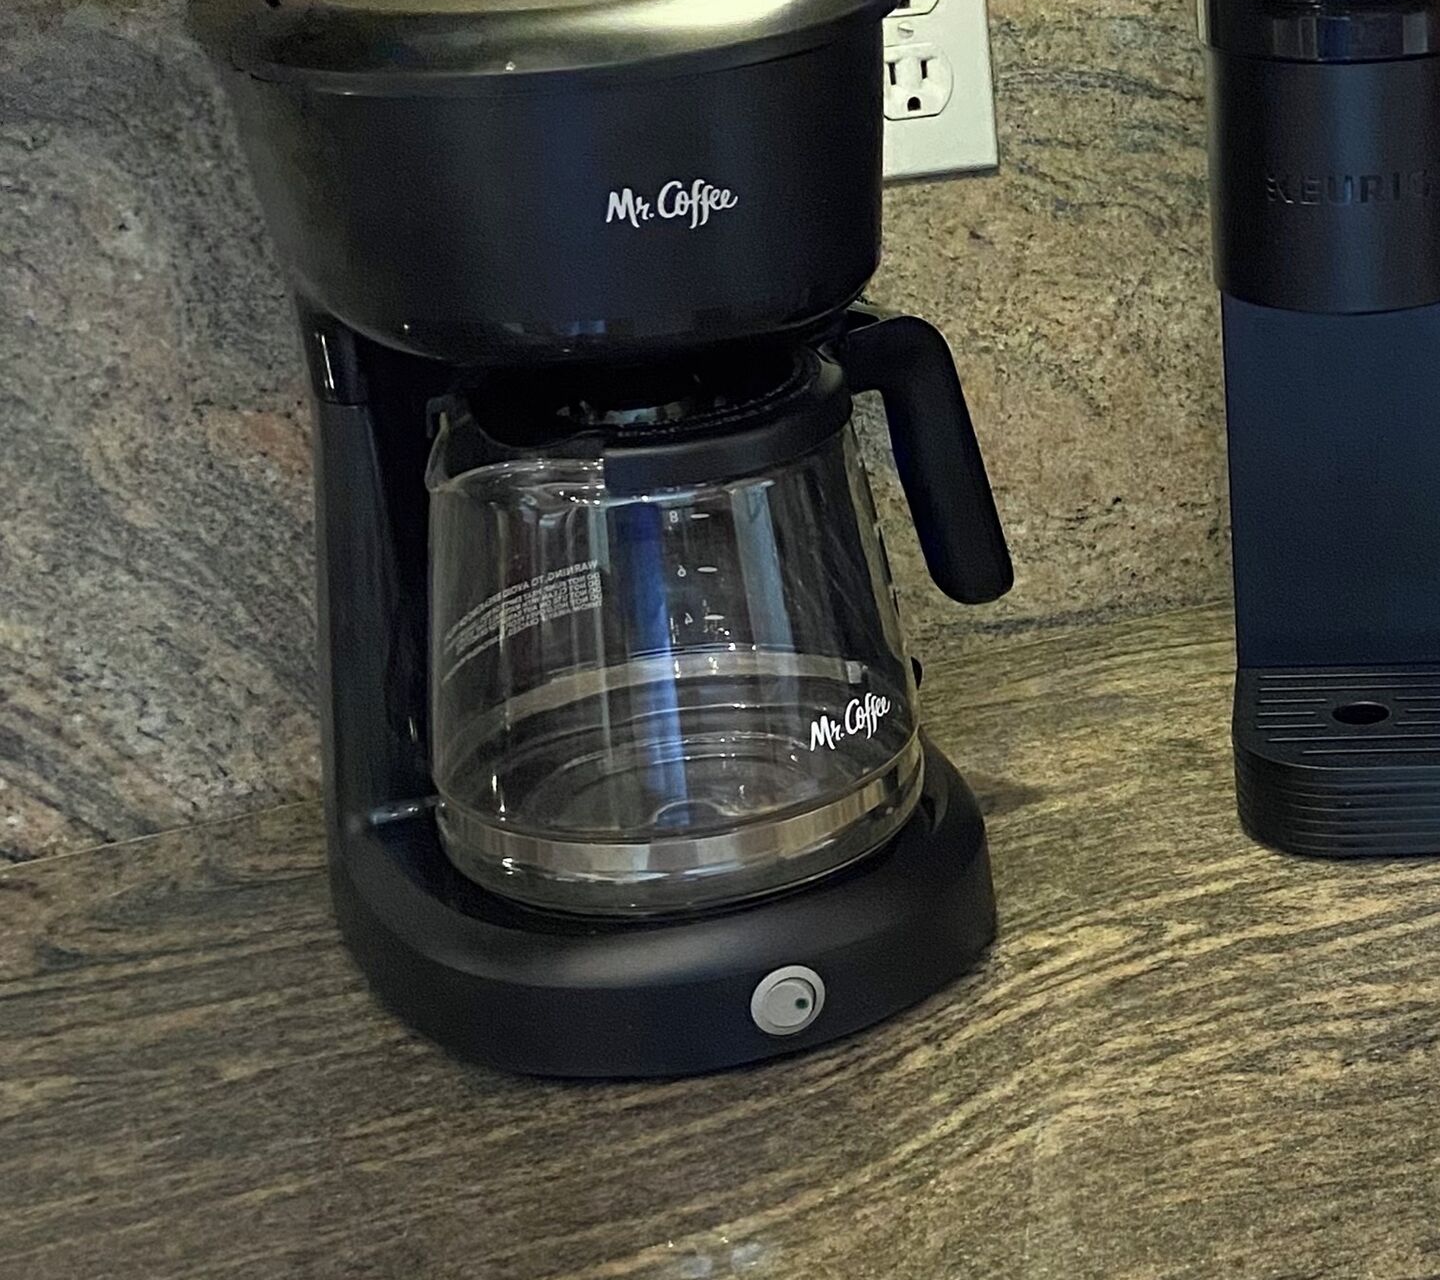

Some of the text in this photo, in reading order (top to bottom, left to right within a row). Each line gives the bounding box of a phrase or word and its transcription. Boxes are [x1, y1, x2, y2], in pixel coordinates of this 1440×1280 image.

[606, 179, 738, 229] Mr. Coffee
[810, 693, 890, 751] Mr. Coffee
